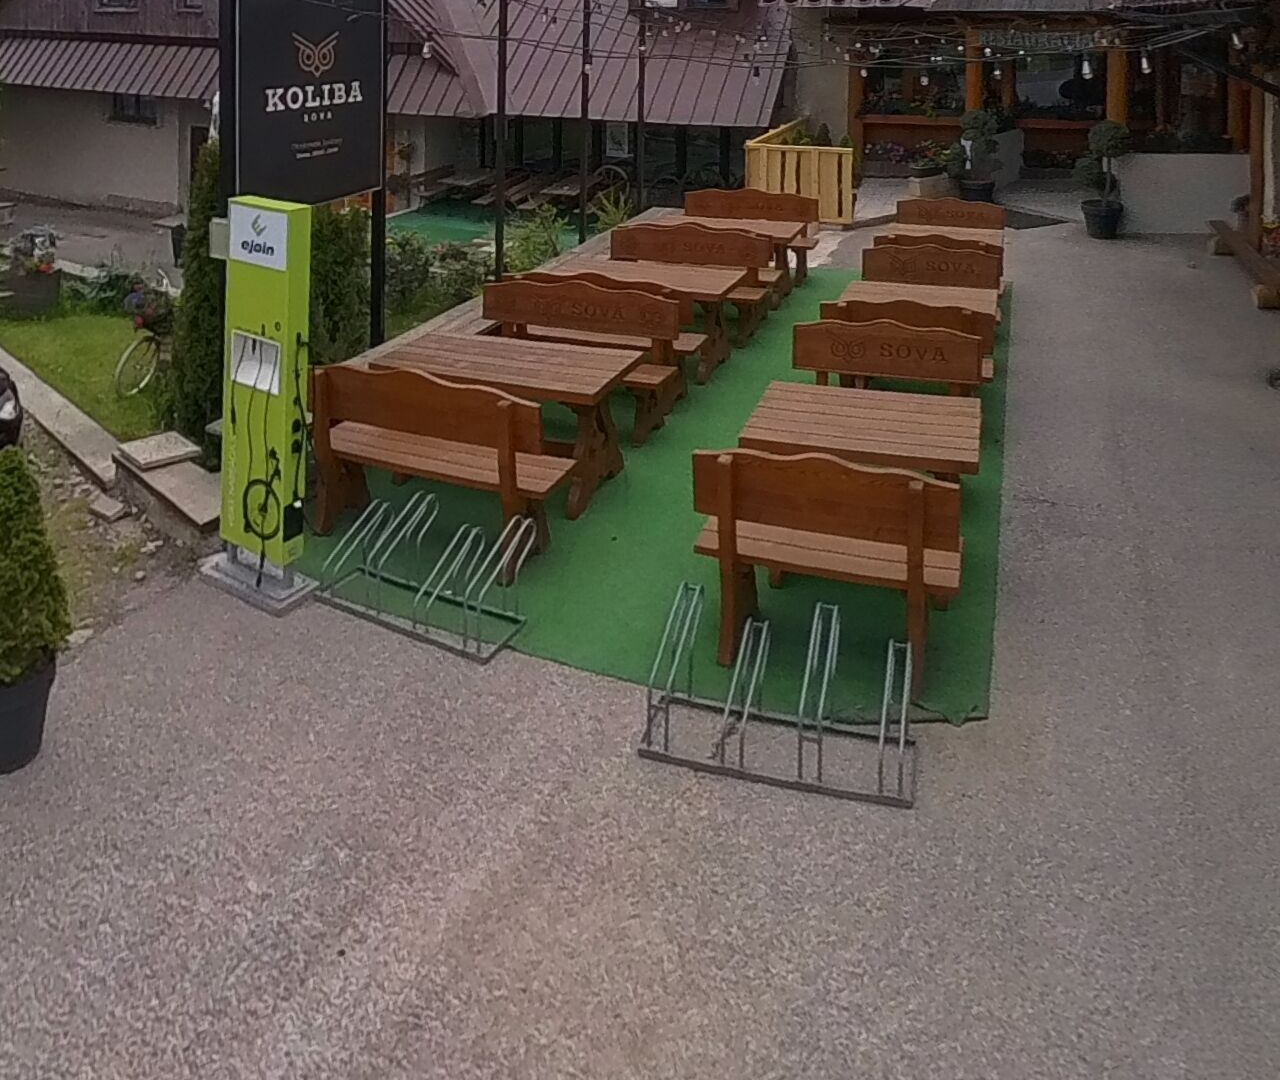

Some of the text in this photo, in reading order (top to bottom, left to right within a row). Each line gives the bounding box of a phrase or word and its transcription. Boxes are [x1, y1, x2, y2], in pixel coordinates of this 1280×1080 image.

[265, 80, 363, 112] KOLIBA
[241, 239, 275, 256] ejoin
[925, 259, 977, 275] SOVA
[571, 302, 625, 321] SOVA
[879, 342, 950, 365] SOVA
